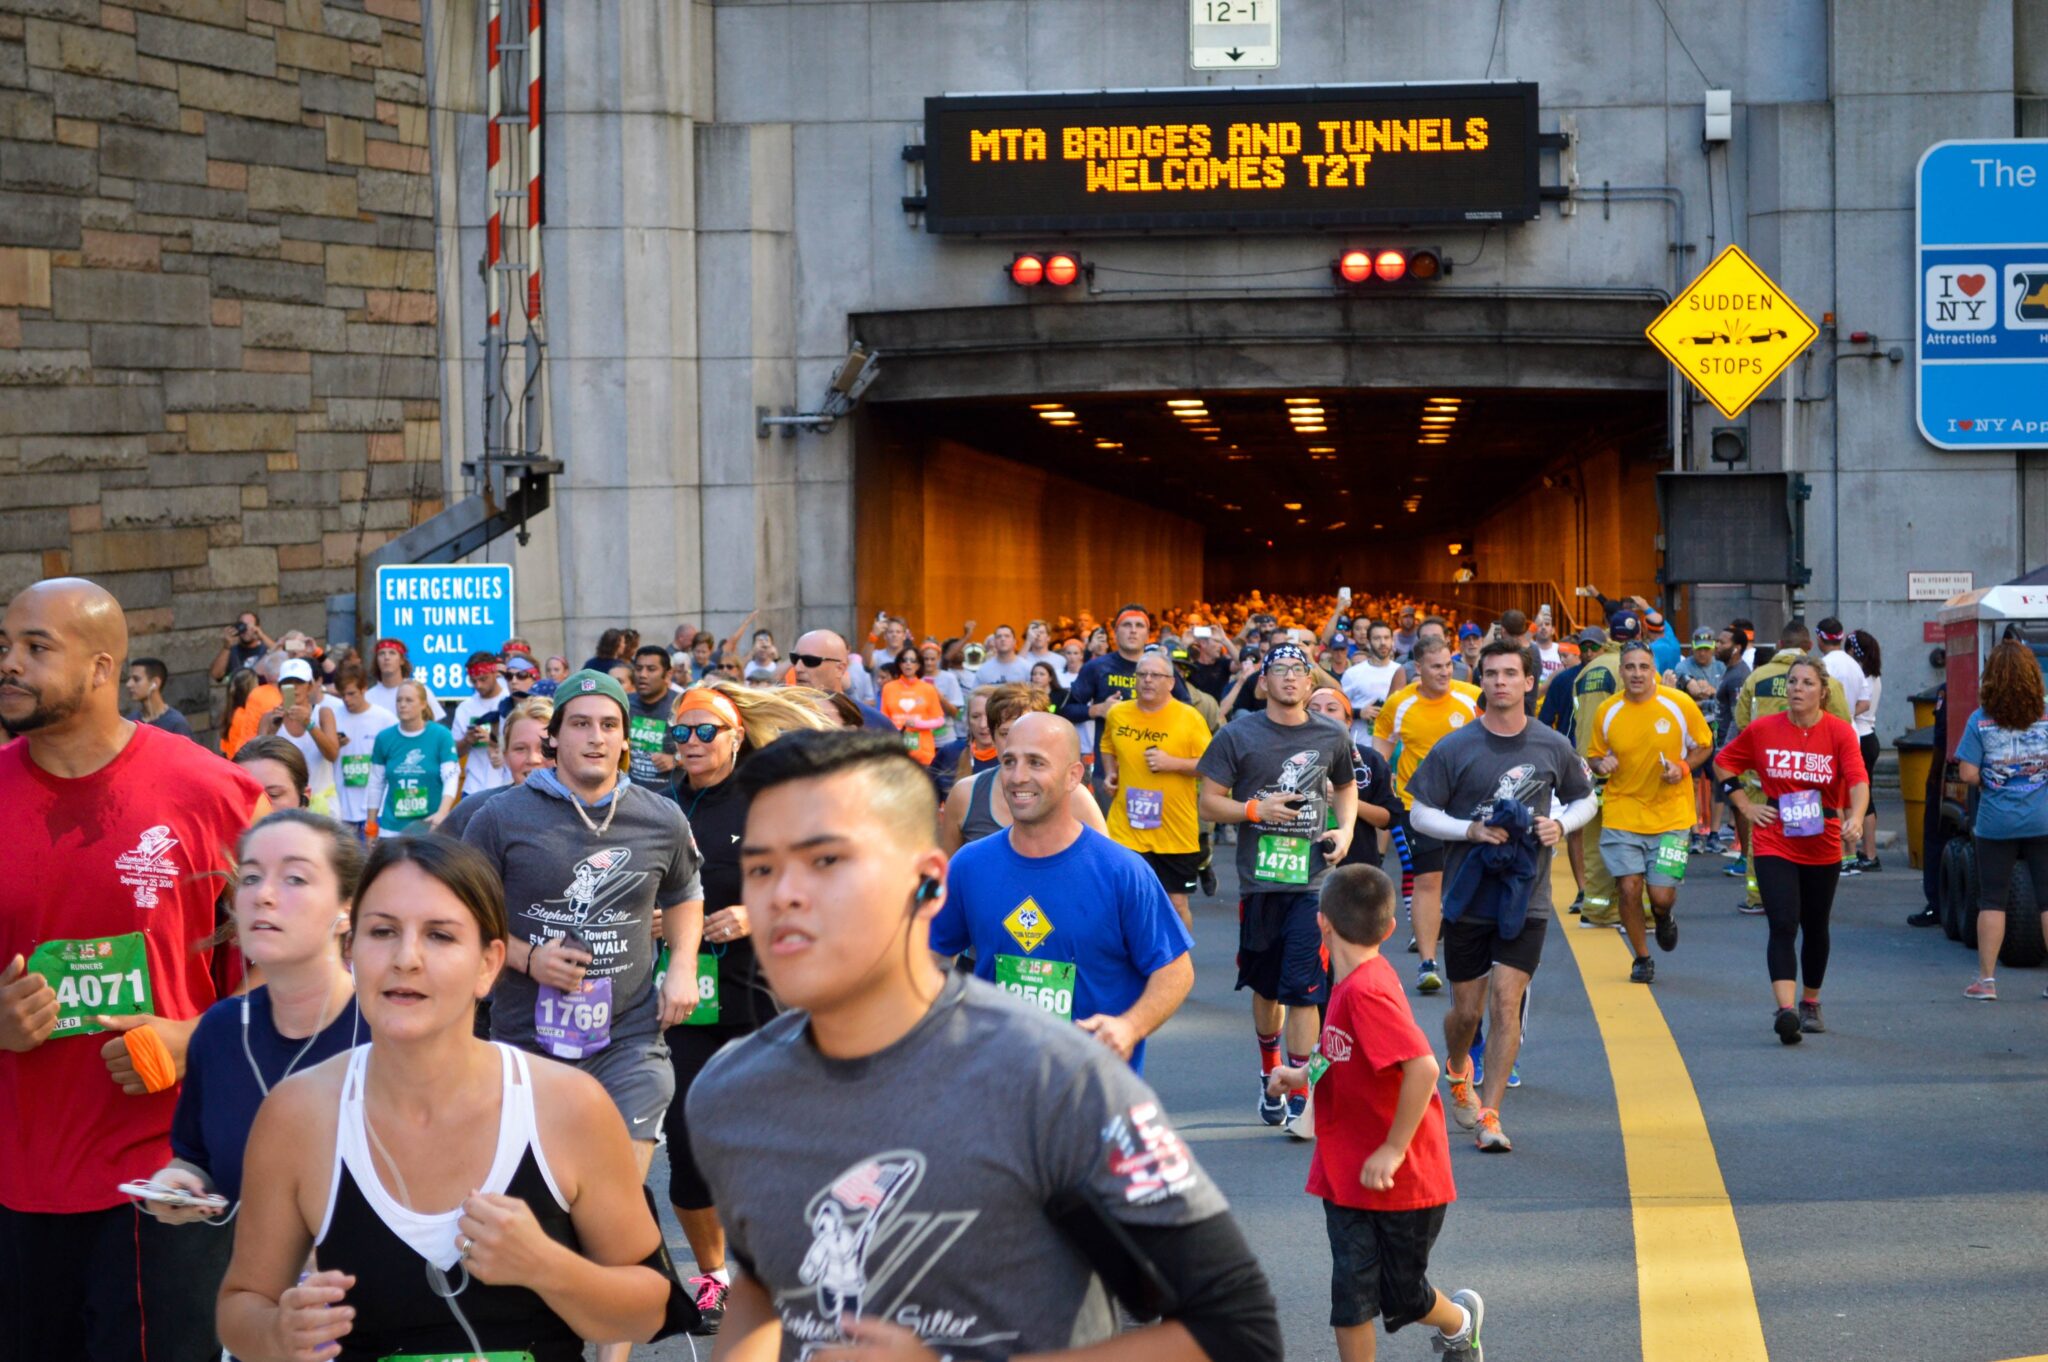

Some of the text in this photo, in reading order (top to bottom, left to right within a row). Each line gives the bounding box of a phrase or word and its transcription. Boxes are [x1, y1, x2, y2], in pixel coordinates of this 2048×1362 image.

[970, 117, 1489, 161] MTA BRIDGES AND TUNNELS
[1086, 154, 1371, 192] WELCOMES T2T
[1970, 158, 2037, 188] The
[1689, 294, 1773, 311] SUDDEN
[1936, 300, 1987, 322] NY
[1926, 333, 1997, 345] Attractions
[1699, 357, 1763, 375] STOPS
[386, 576, 503, 600] EMERGENCIES
[394, 606, 494, 626] IN TUNNEL
[423, 634, 468, 654] CALL
[413, 663, 474, 689] #88
[1108, 675, 1137, 688] MICH
[1116, 725, 1168, 742] stryker
[1766, 749, 1833, 774] T2T 5K
[1767, 768, 1833, 784] TEAM OGILVY
[1128, 799, 1160, 815] 1271
[1298, 810, 1318, 820] WALK
[1782, 802, 1820, 822] 3940
[1258, 851, 1307, 872] 14731
[527, 904, 576, 924] Stephen
[543, 925, 617, 941] Tunn Towers
[593, 940, 628, 955] WALK
[70, 962, 104, 970] RUNNERS
[593, 957, 614, 965] CITY
[541, 998, 609, 1031] 1769
[897, 1304, 978, 1337] Siller
